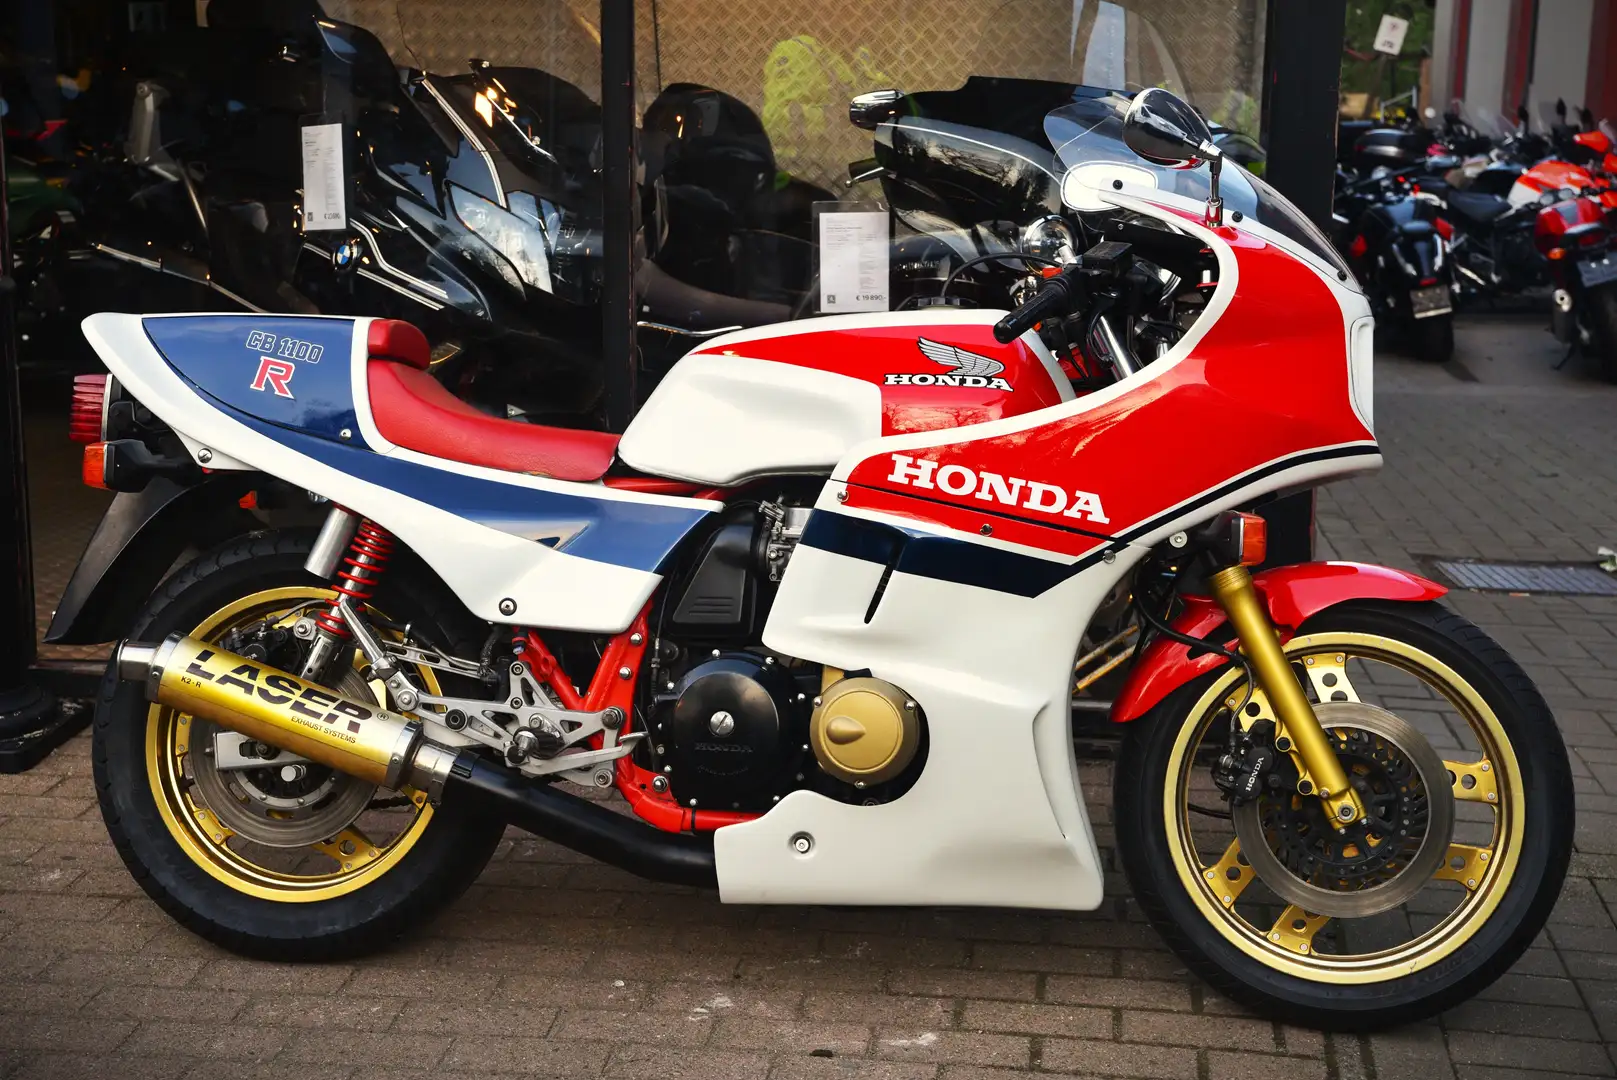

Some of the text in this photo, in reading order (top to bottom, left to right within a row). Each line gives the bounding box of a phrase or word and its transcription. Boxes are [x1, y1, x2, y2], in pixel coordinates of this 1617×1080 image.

[246, 330, 324, 364] CB 1100
[250, 356, 296, 399] R
[884, 373, 1014, 392] HONDA
[887, 453, 1110, 525] HONDA
[185, 649, 373, 734] LASER
[291, 715, 356, 744] EXHAUST SYSTEMS
[694, 742, 754, 753] HONDA
[1245, 757, 1265, 791] HONDA
